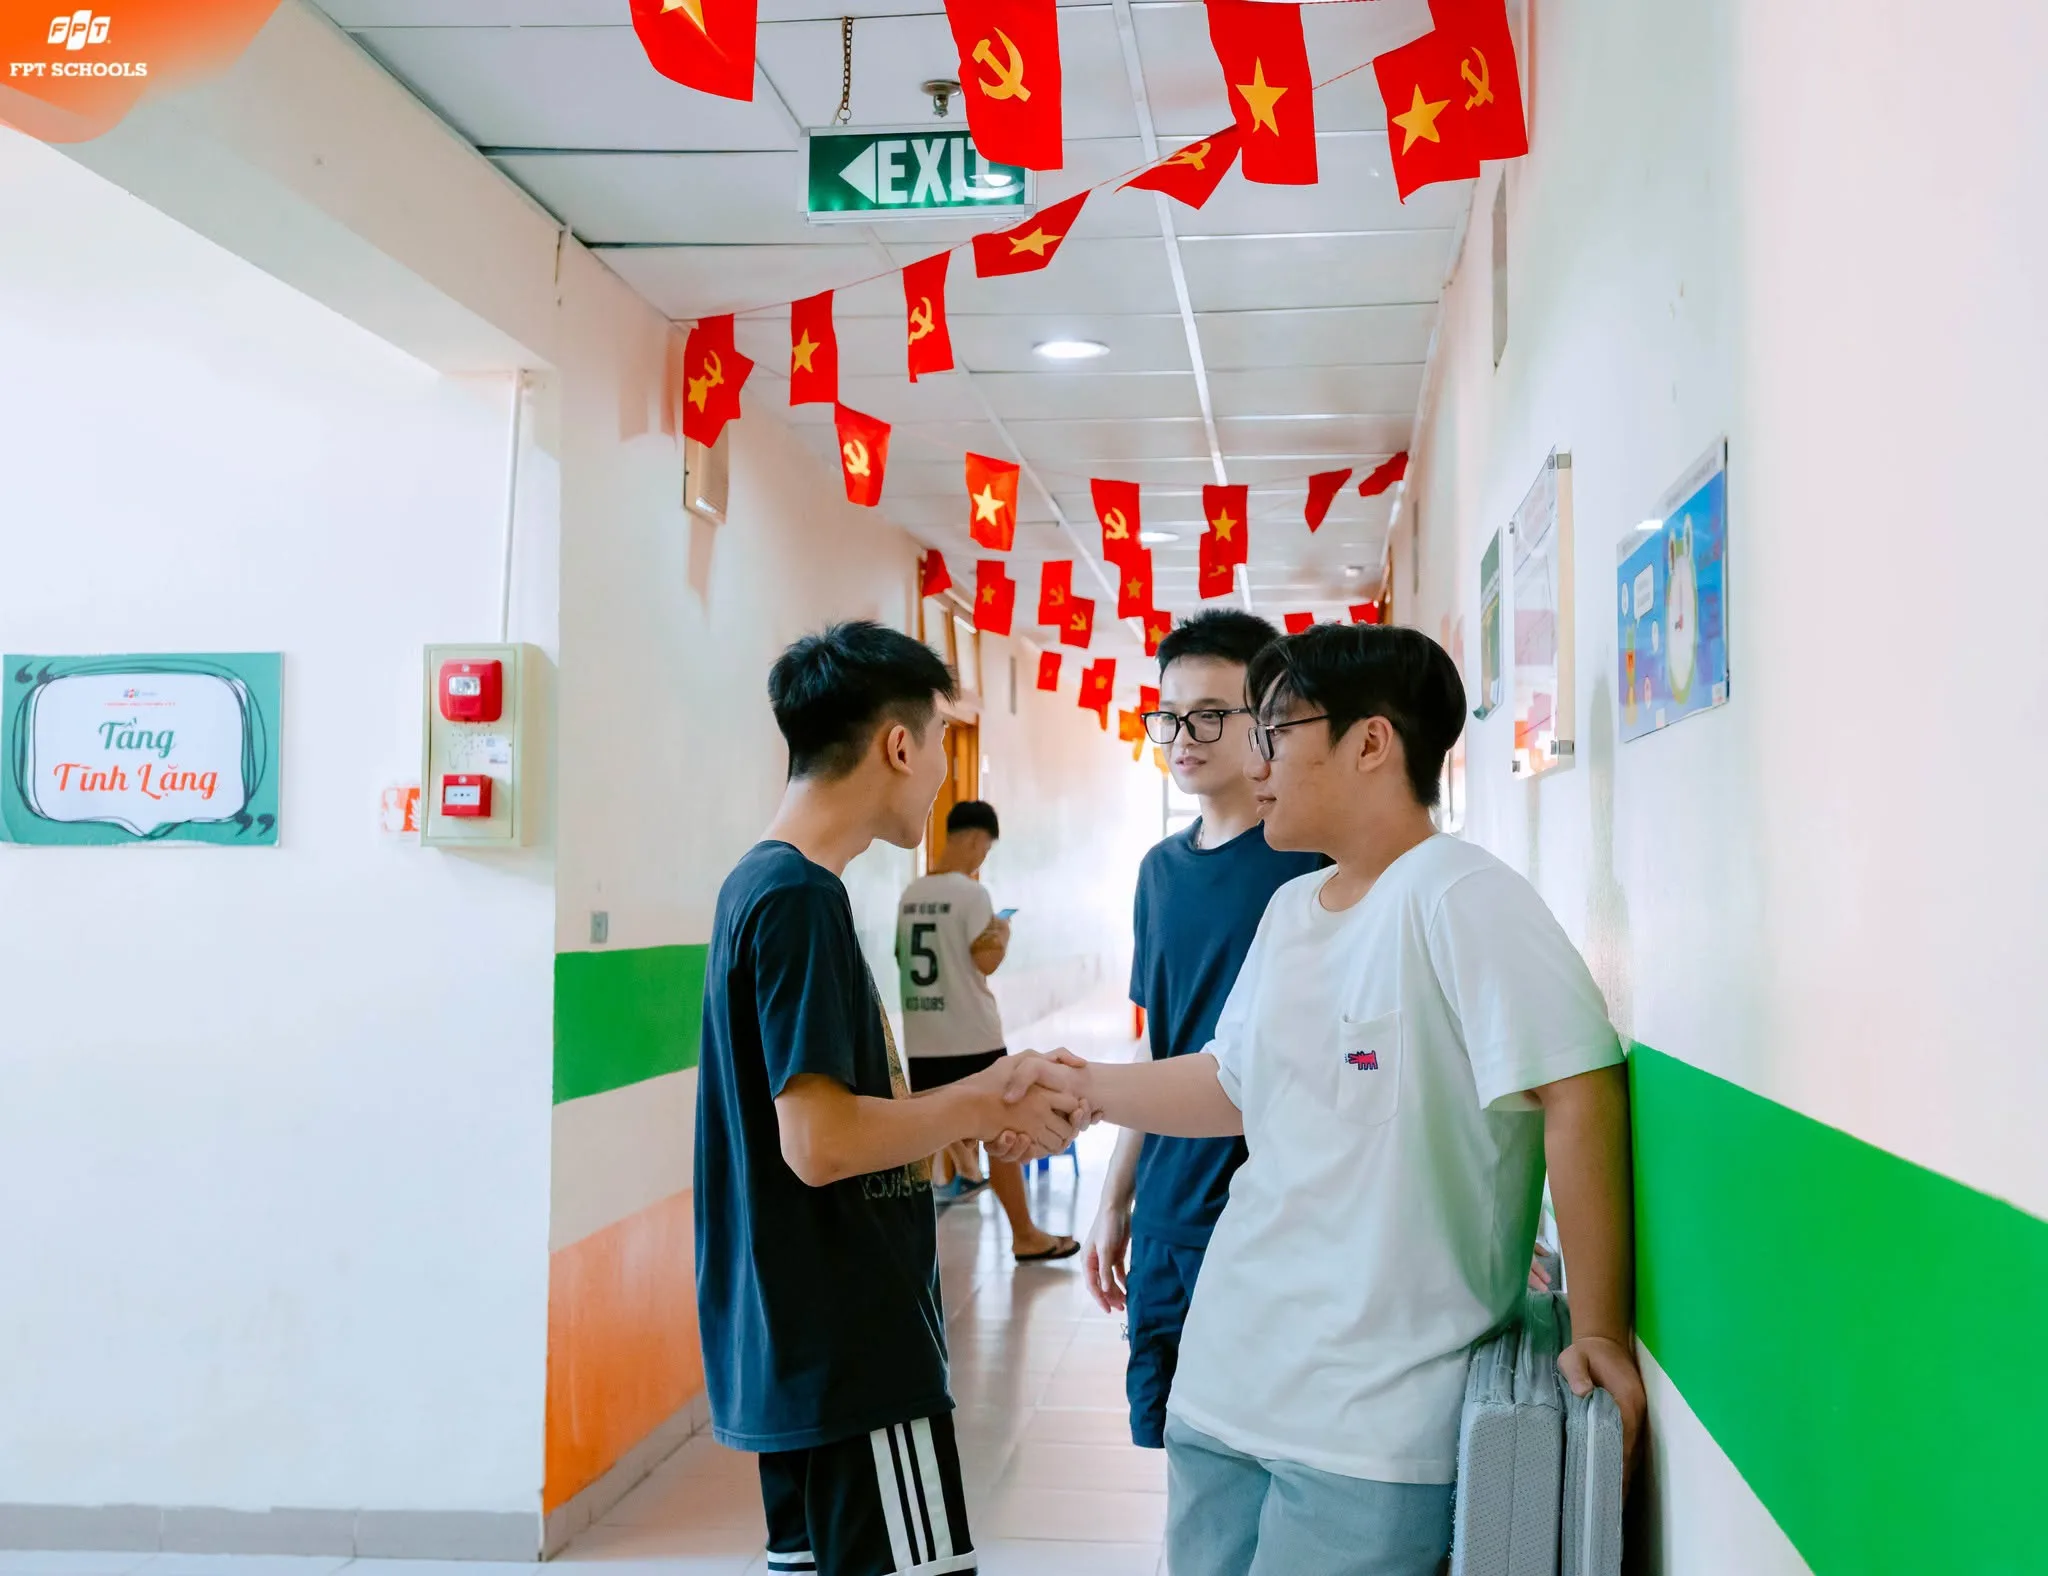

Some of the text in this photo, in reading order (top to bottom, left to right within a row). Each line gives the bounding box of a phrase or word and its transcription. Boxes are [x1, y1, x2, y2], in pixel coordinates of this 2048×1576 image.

[98, 717, 175, 759] Tầng
[53, 763, 219, 801] Tĩnh Lặng
[910, 923, 938, 986] 5
